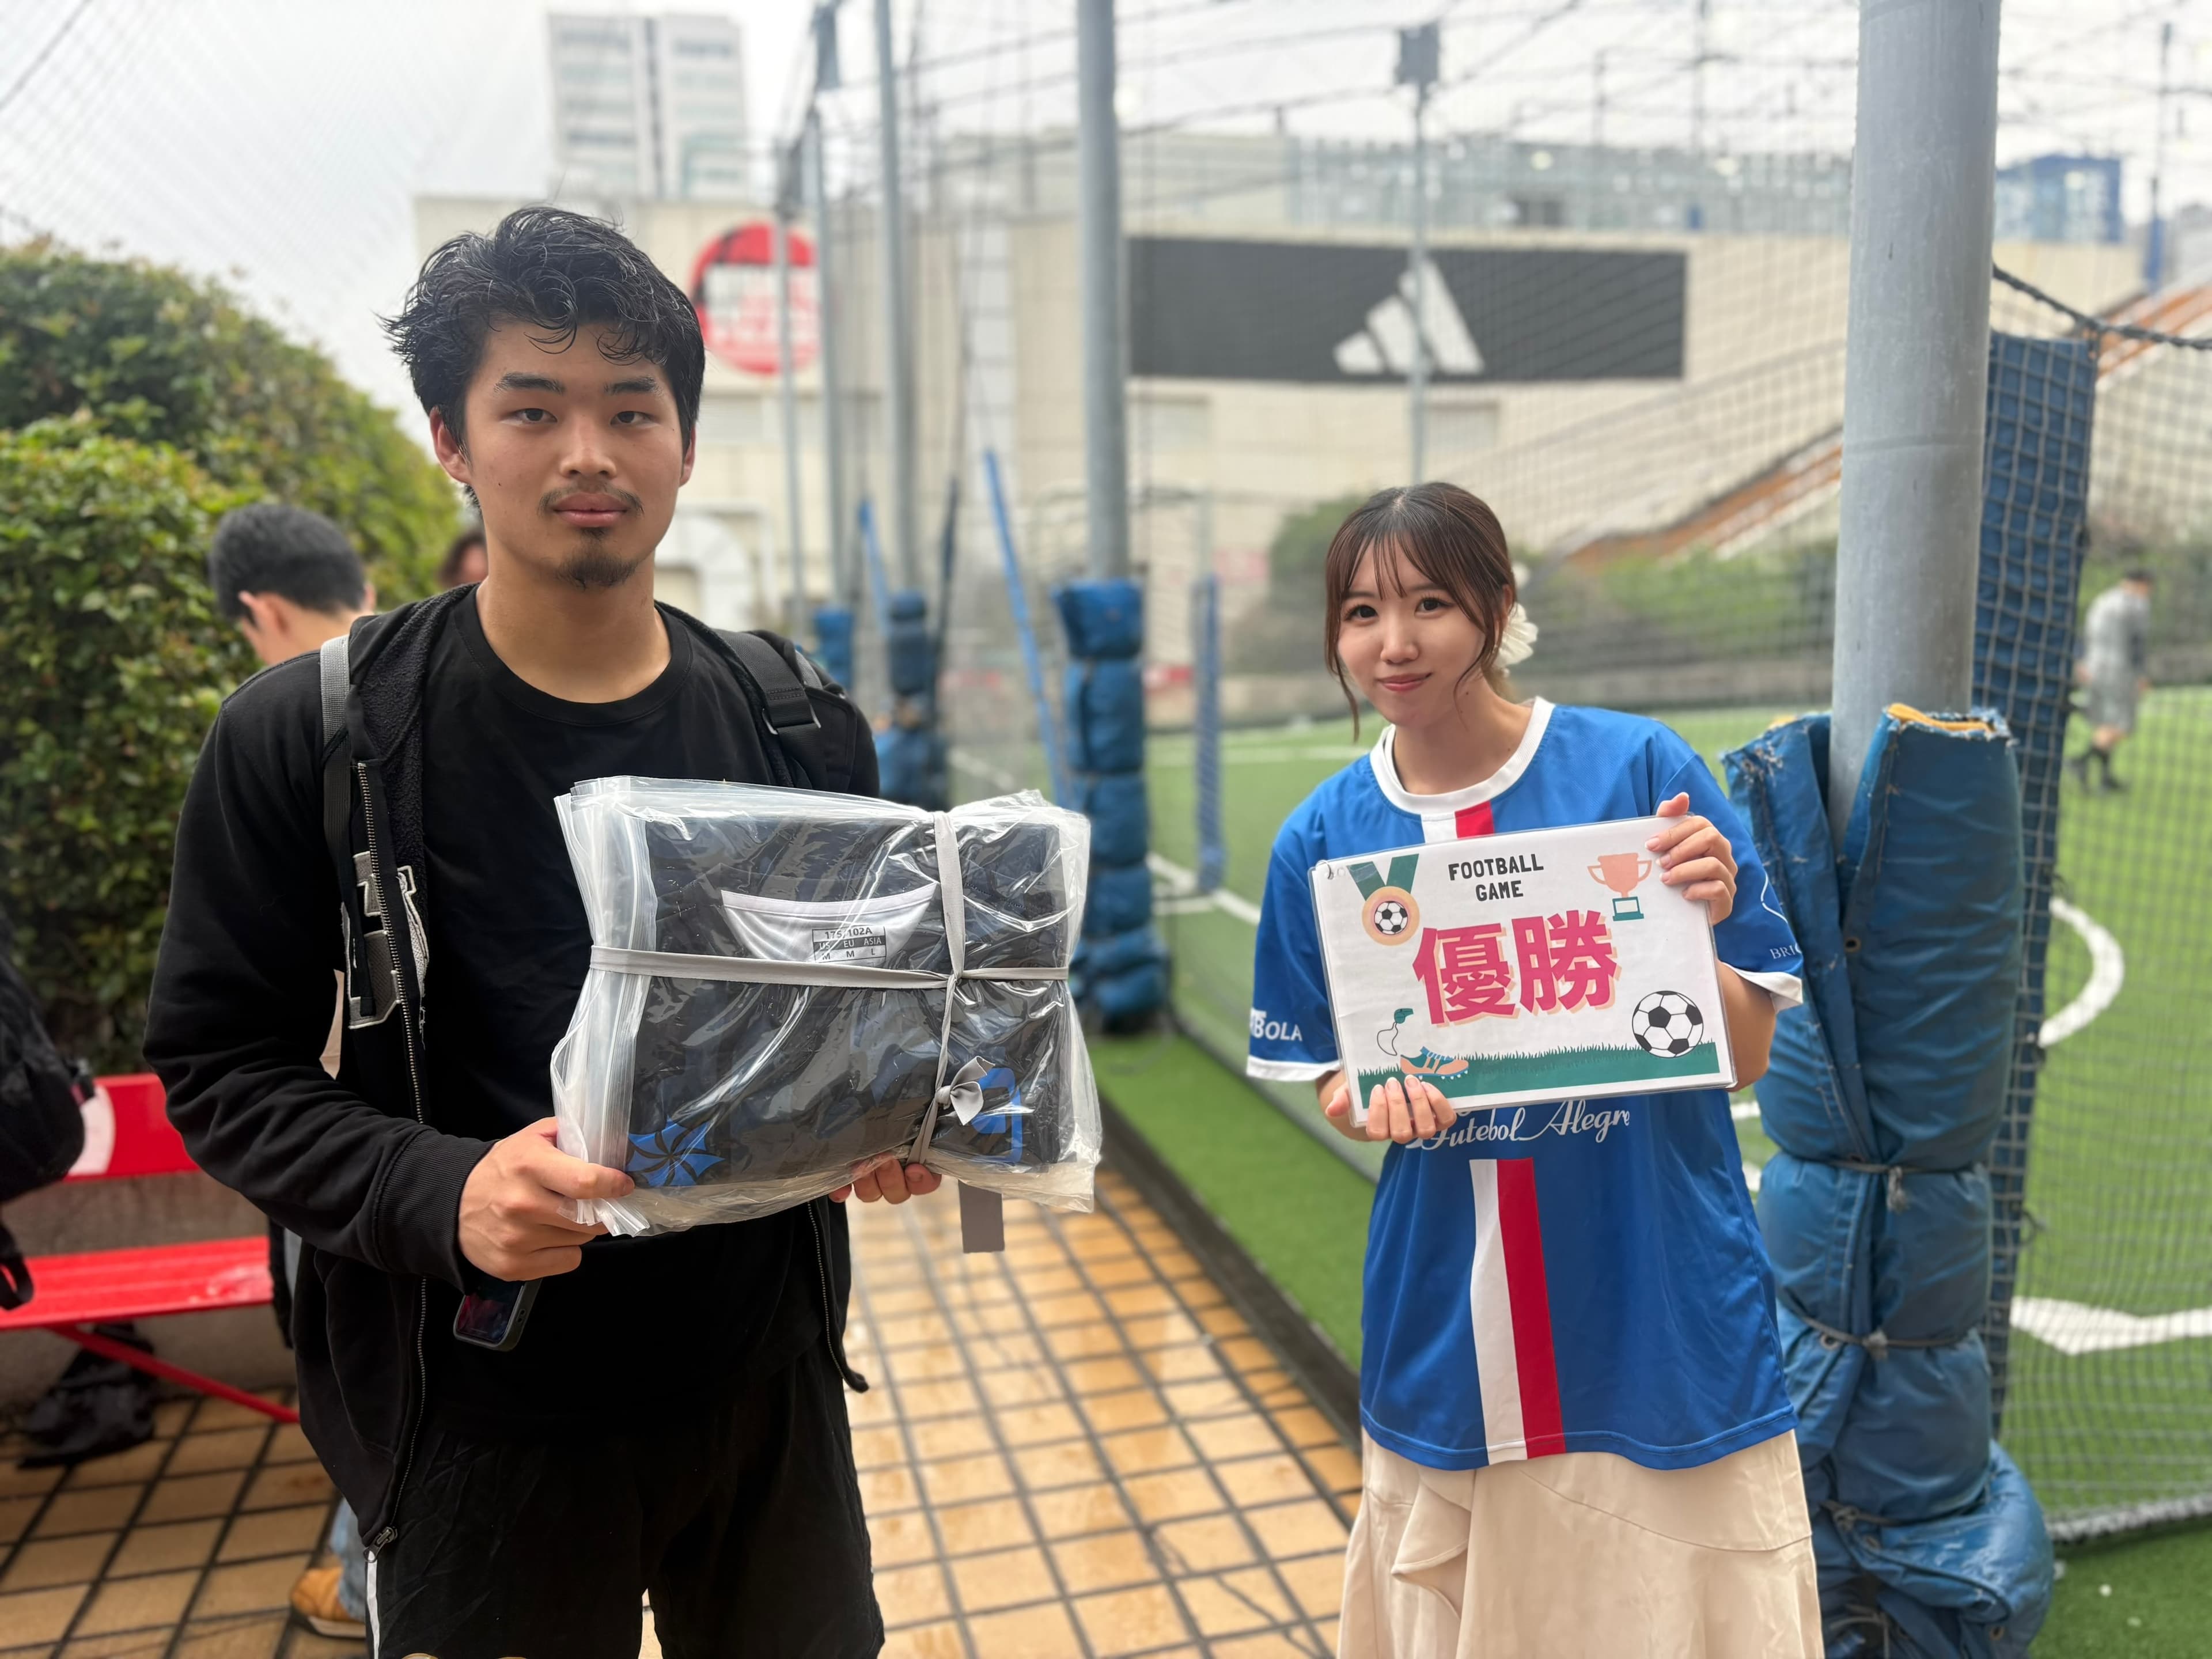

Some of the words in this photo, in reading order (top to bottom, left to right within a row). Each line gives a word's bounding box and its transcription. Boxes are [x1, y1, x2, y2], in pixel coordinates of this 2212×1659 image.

[1448, 853, 1544, 881] FOOTBALL
[1475, 880, 1524, 902] GAME
[824, 927, 873, 939] 175/102A
[819, 941, 831, 950] US
[843, 940, 855, 948] EU
[863, 937, 882, 945] ASIA
[846, 950, 855, 958] M
[870, 948, 876, 956] L
[1412, 910, 1622, 1027] 優勝
